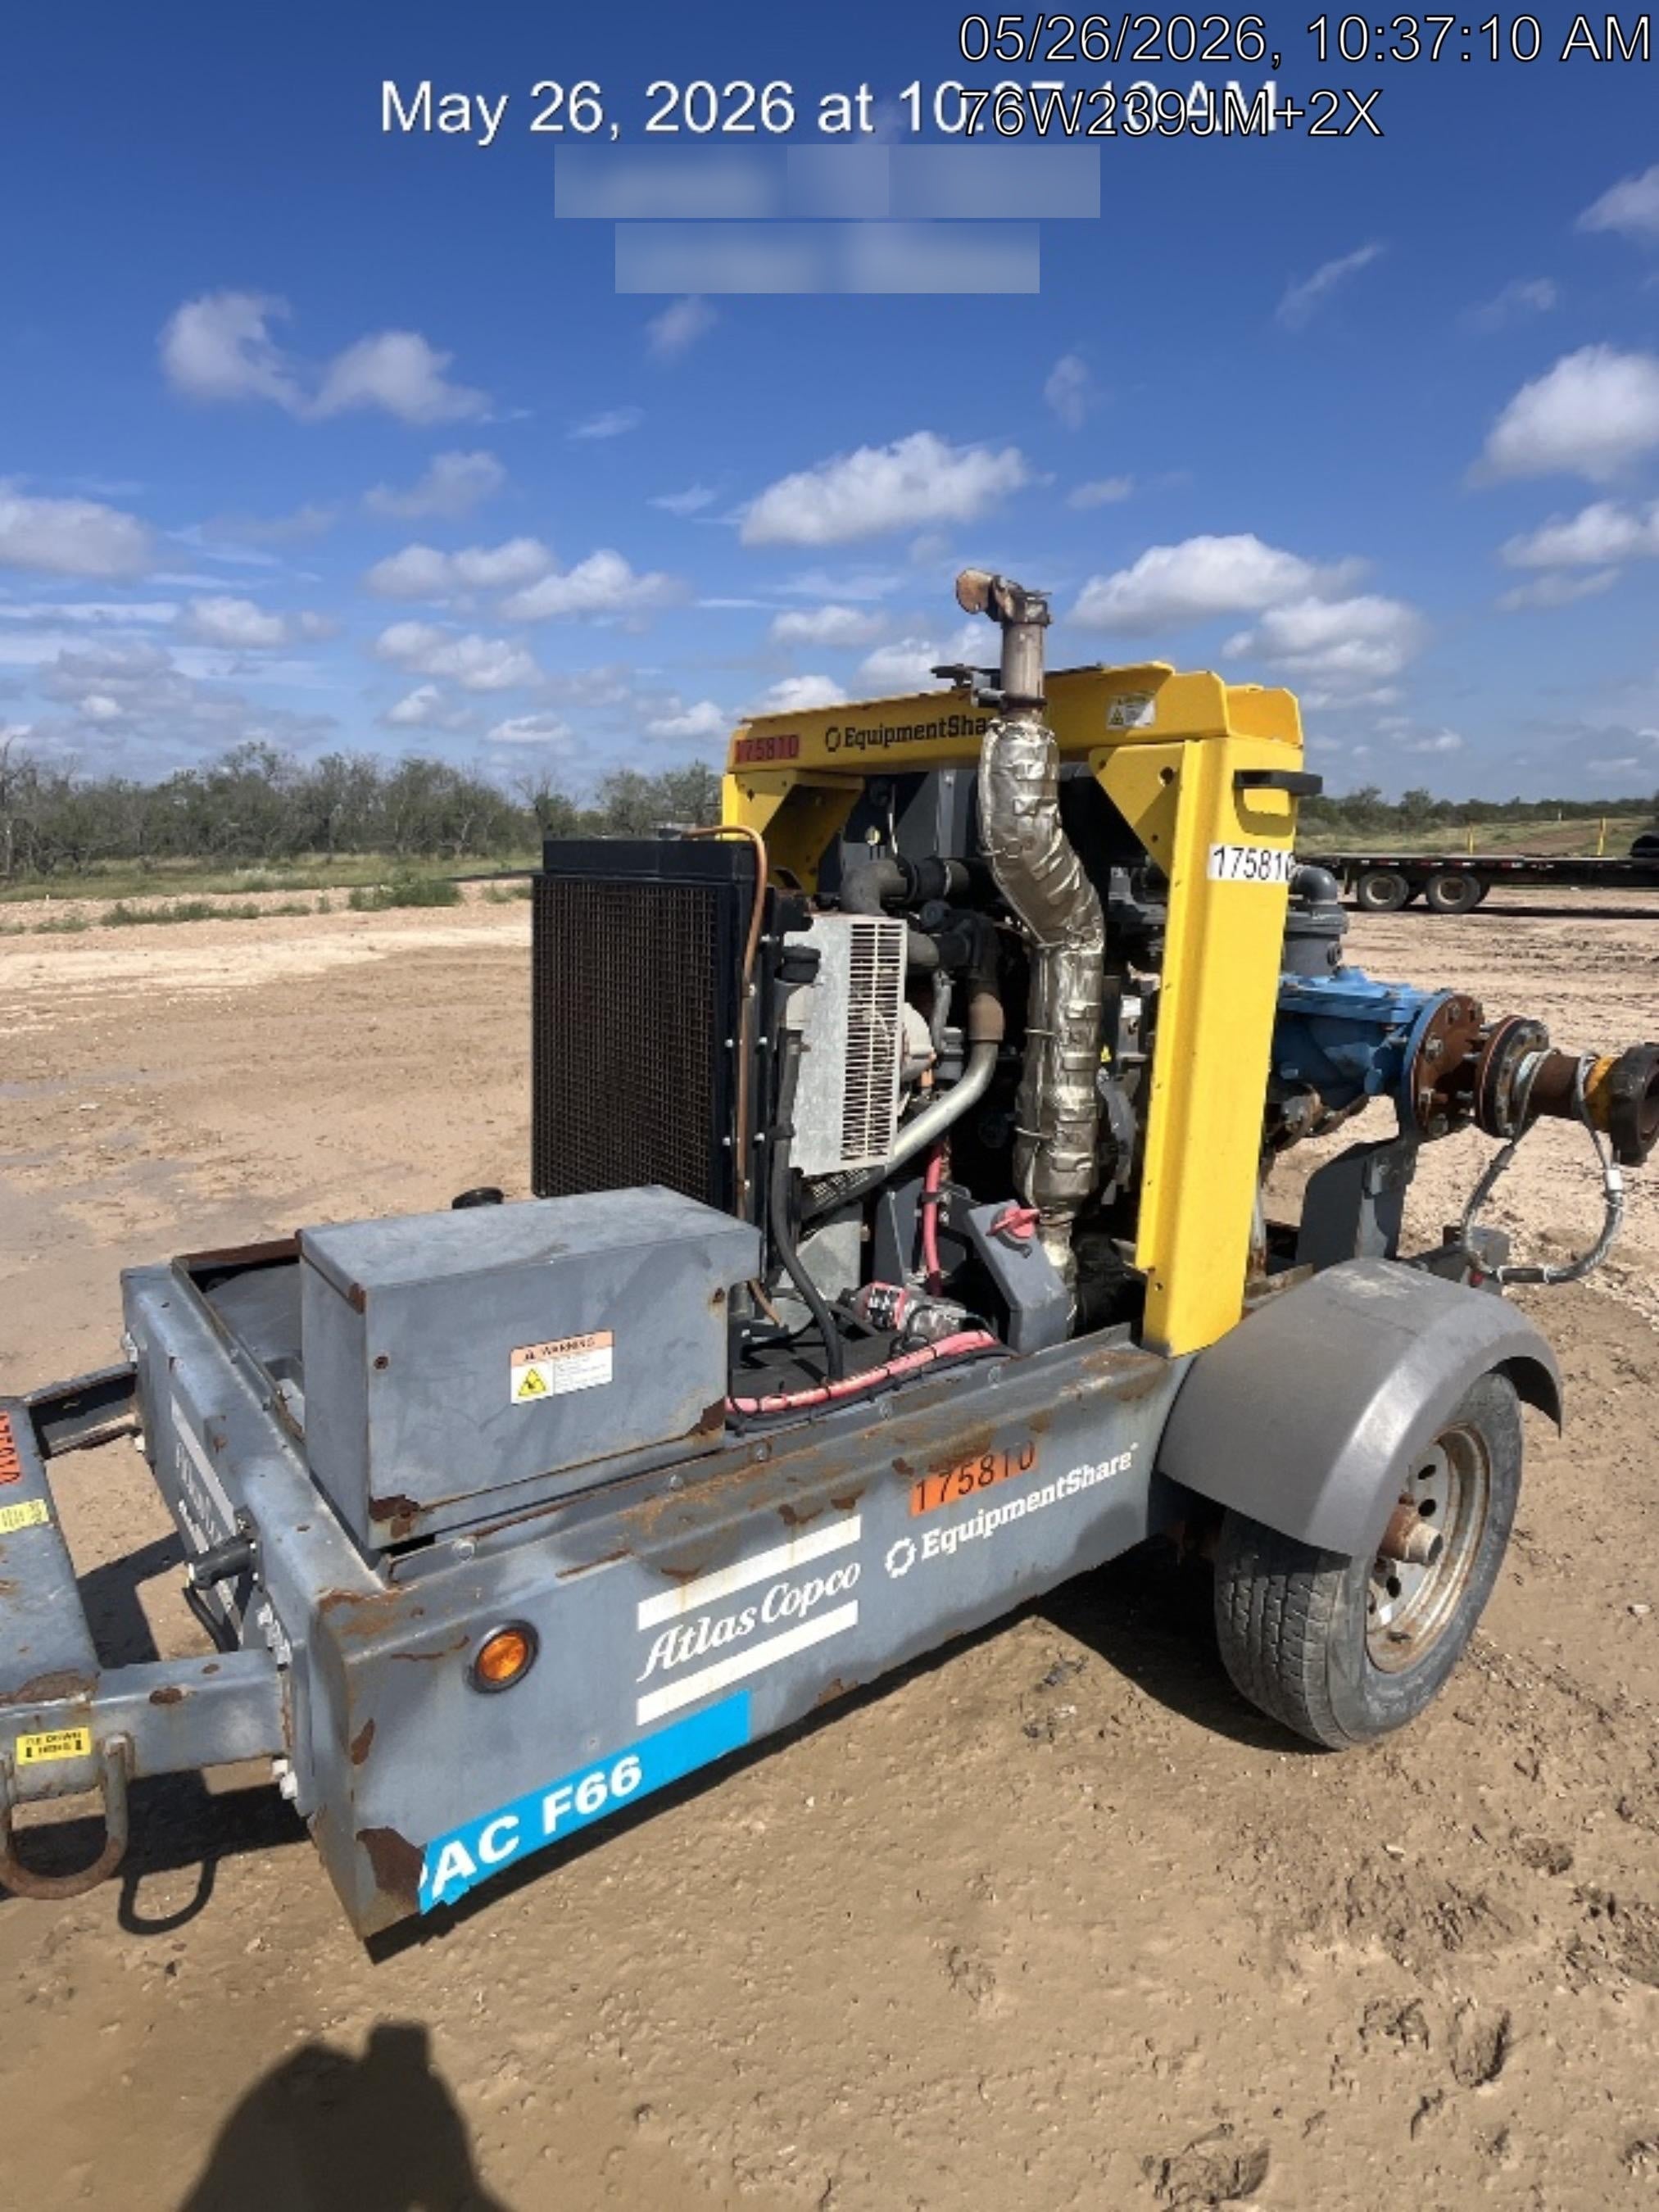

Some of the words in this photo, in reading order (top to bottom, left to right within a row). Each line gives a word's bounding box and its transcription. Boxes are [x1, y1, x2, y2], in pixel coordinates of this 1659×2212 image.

[915, 1439, 1036, 1512] 175810
[922, 1451, 1132, 1561] EquipmentShare
[636, 1603, 756, 1683] Atlas
[760, 1562, 862, 1626] Copco
[418, 1815, 521, 1899] AC
[542, 1754, 643, 1836] F66
